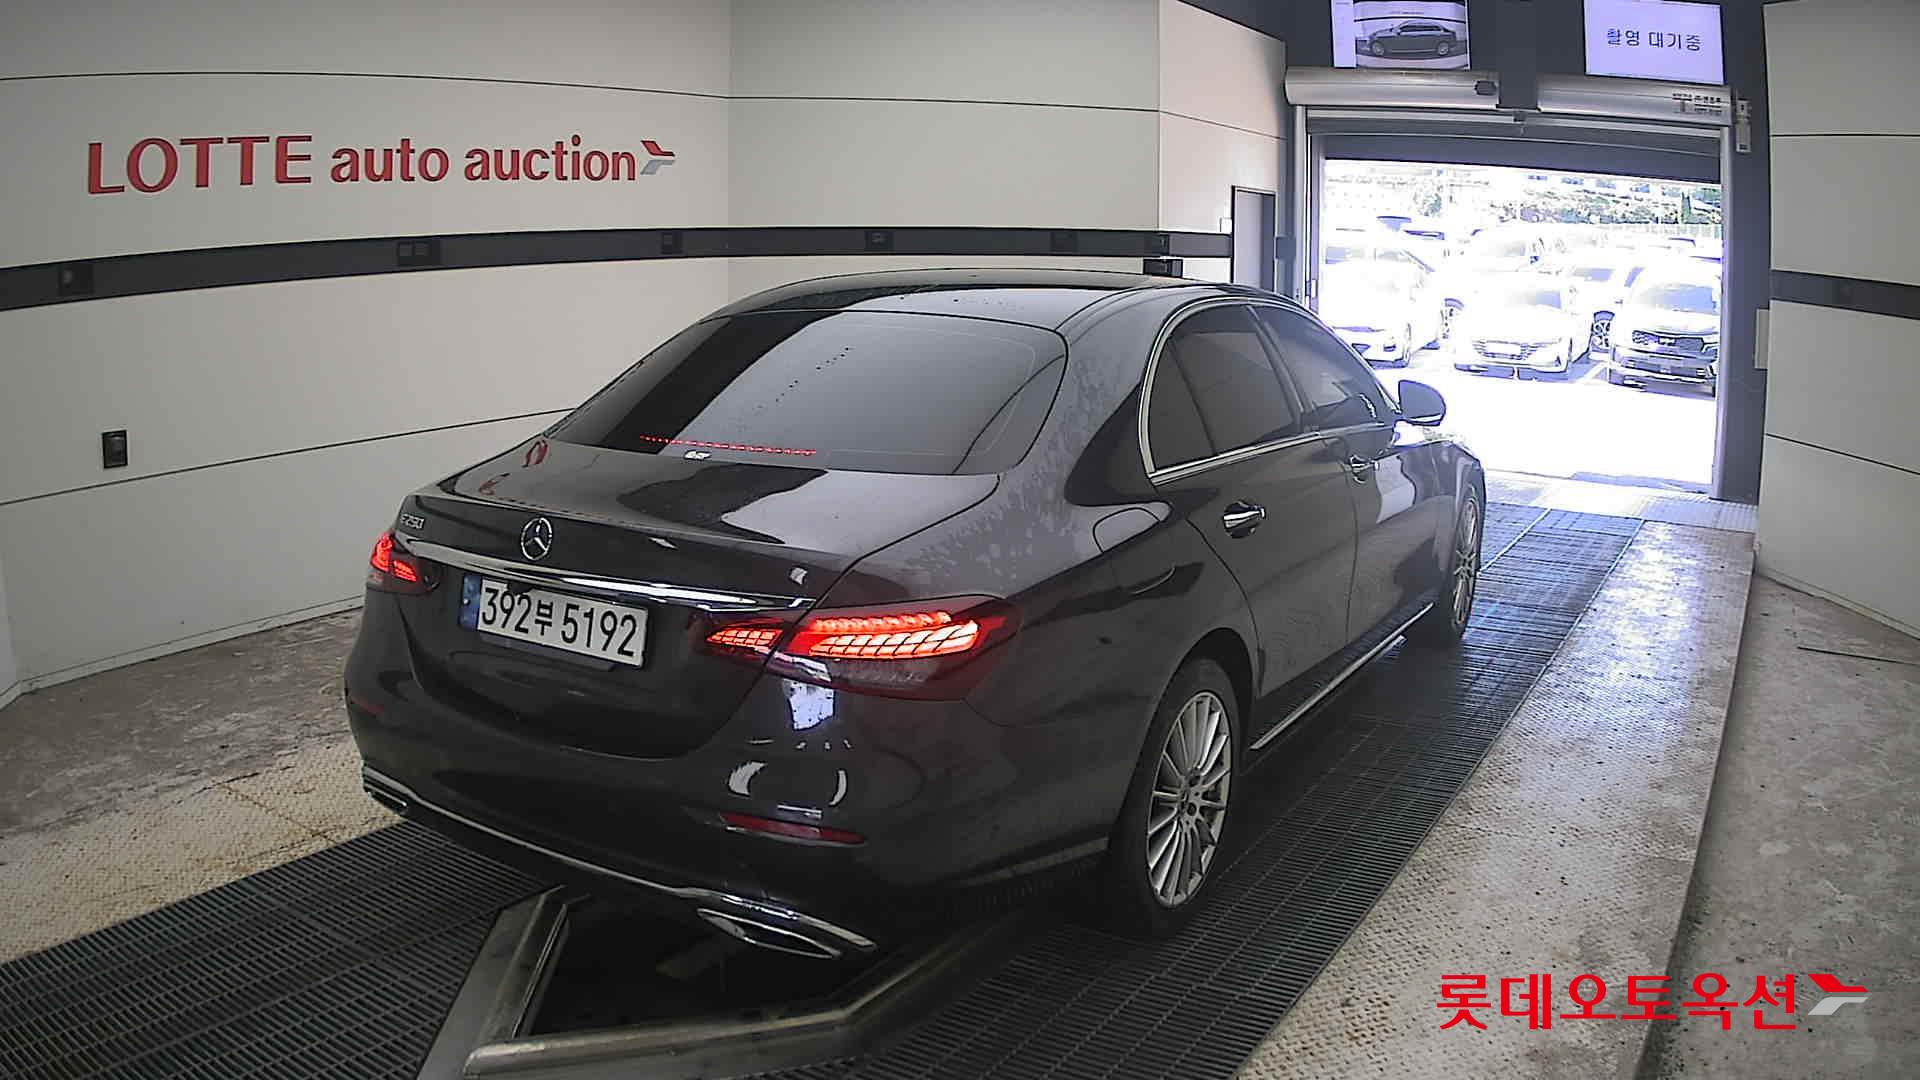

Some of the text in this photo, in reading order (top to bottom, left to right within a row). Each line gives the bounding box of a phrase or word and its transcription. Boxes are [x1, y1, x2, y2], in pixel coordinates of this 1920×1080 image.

[1648, 31, 1701, 52] 대기중
[88, 134, 636, 194] LOTTE auto auction
[481, 587, 637, 657] 392부 5192
